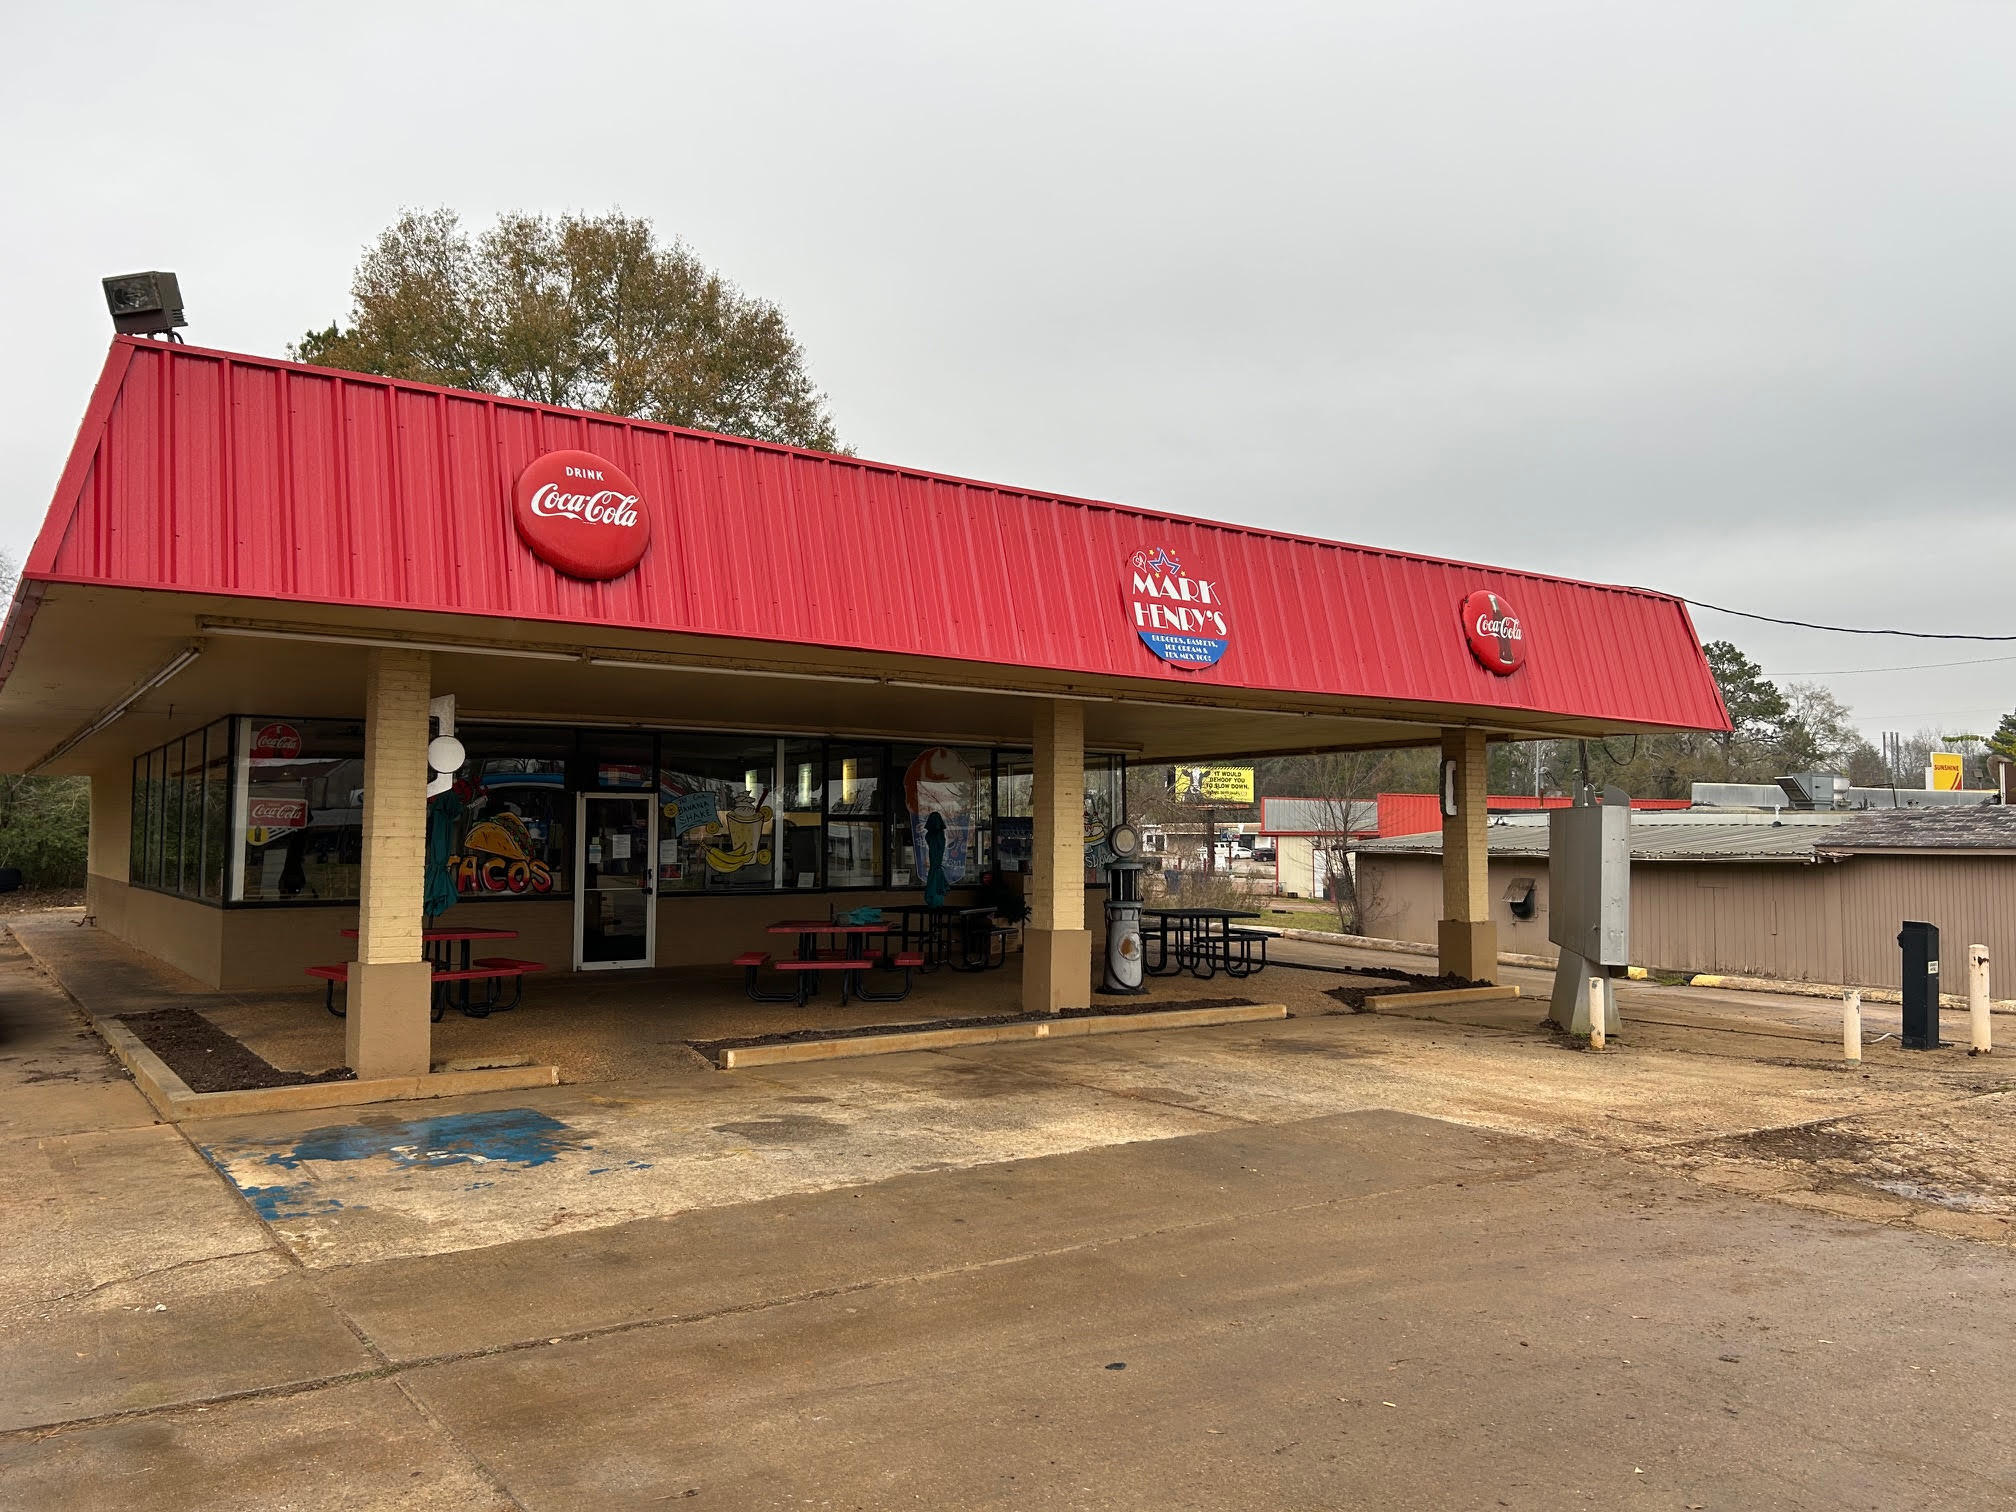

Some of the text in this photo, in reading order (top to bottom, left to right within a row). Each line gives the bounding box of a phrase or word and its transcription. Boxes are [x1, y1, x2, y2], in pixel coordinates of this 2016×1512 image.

[566, 466, 604, 481] DRINK
[531, 483, 639, 527] Coca-Cola
[1132, 571, 1221, 606] MARK
[1133, 601, 1227, 636] HENRY'S
[1476, 613, 1522, 640] Coca-Cola
[258, 735, 298, 749] Coca-Cola
[252, 804, 303, 820] Coca-Cola
